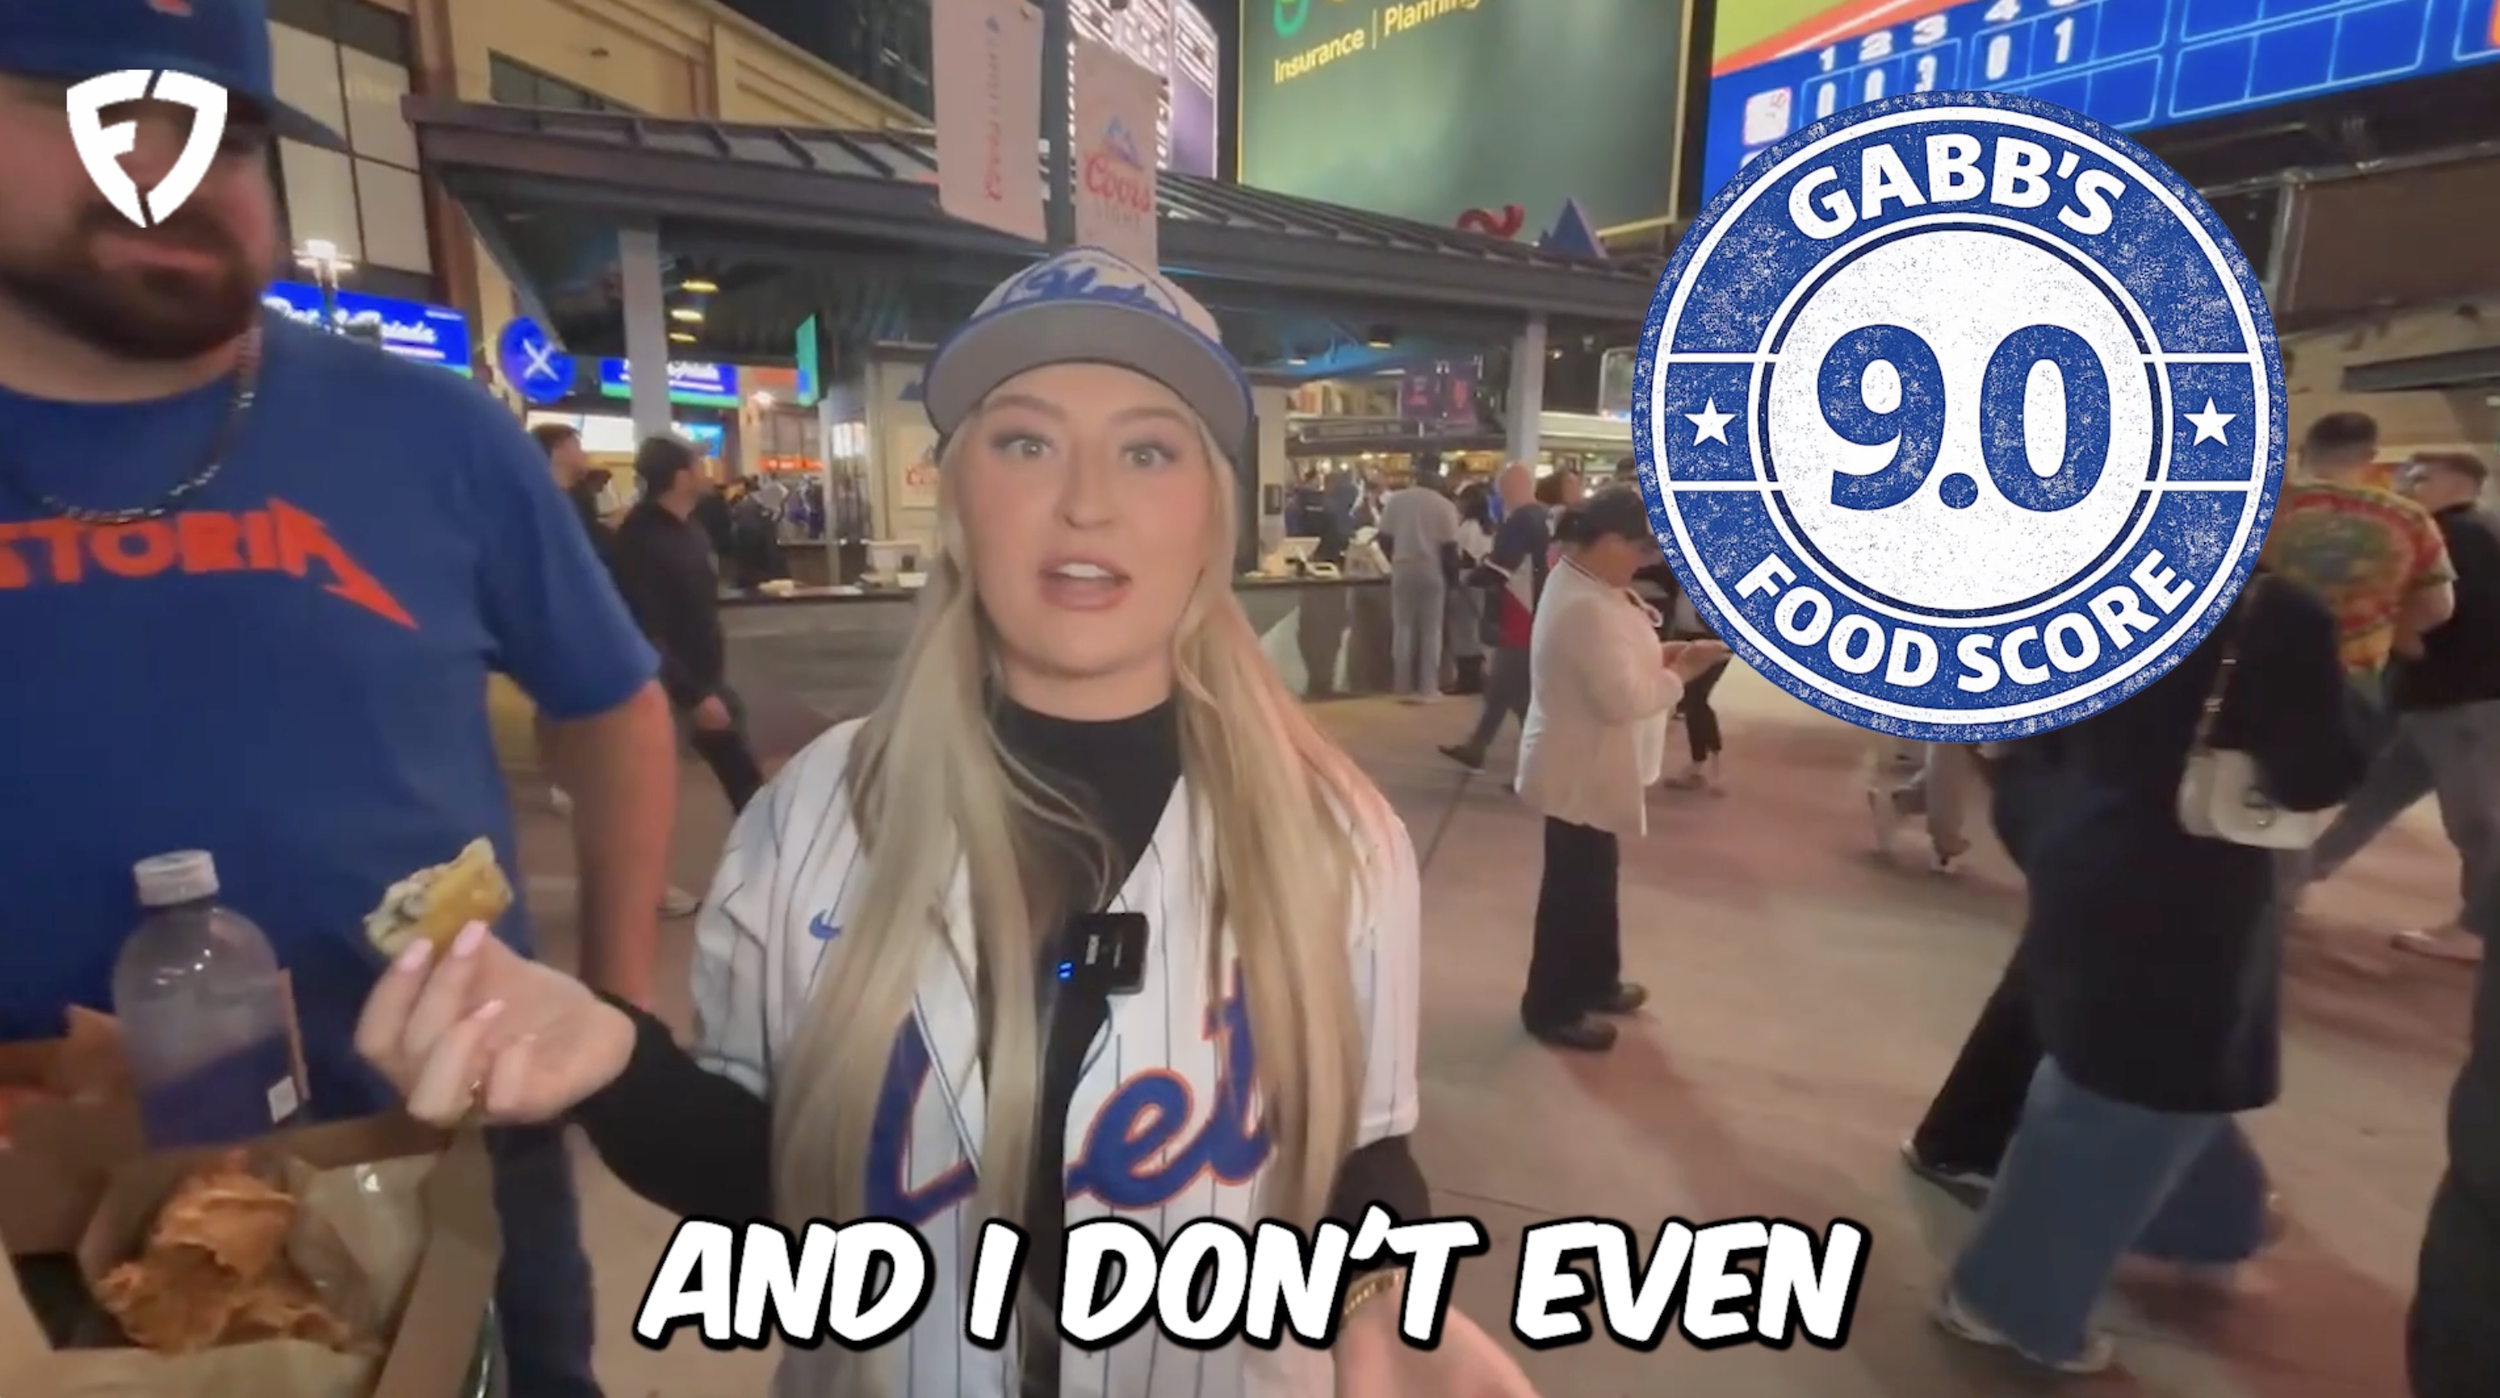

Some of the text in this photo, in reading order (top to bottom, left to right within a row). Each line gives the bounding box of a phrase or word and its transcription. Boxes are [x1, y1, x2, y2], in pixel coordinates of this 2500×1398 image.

[1273, 28, 1365, 84] Insurance
[1819, 46, 1835, 72] 1
[1859, 31, 1892, 62] 2
[1912, 15, 1947, 45] 3
[2055, 18, 2074, 63] 1
[1084, 151, 1150, 213] Coors
